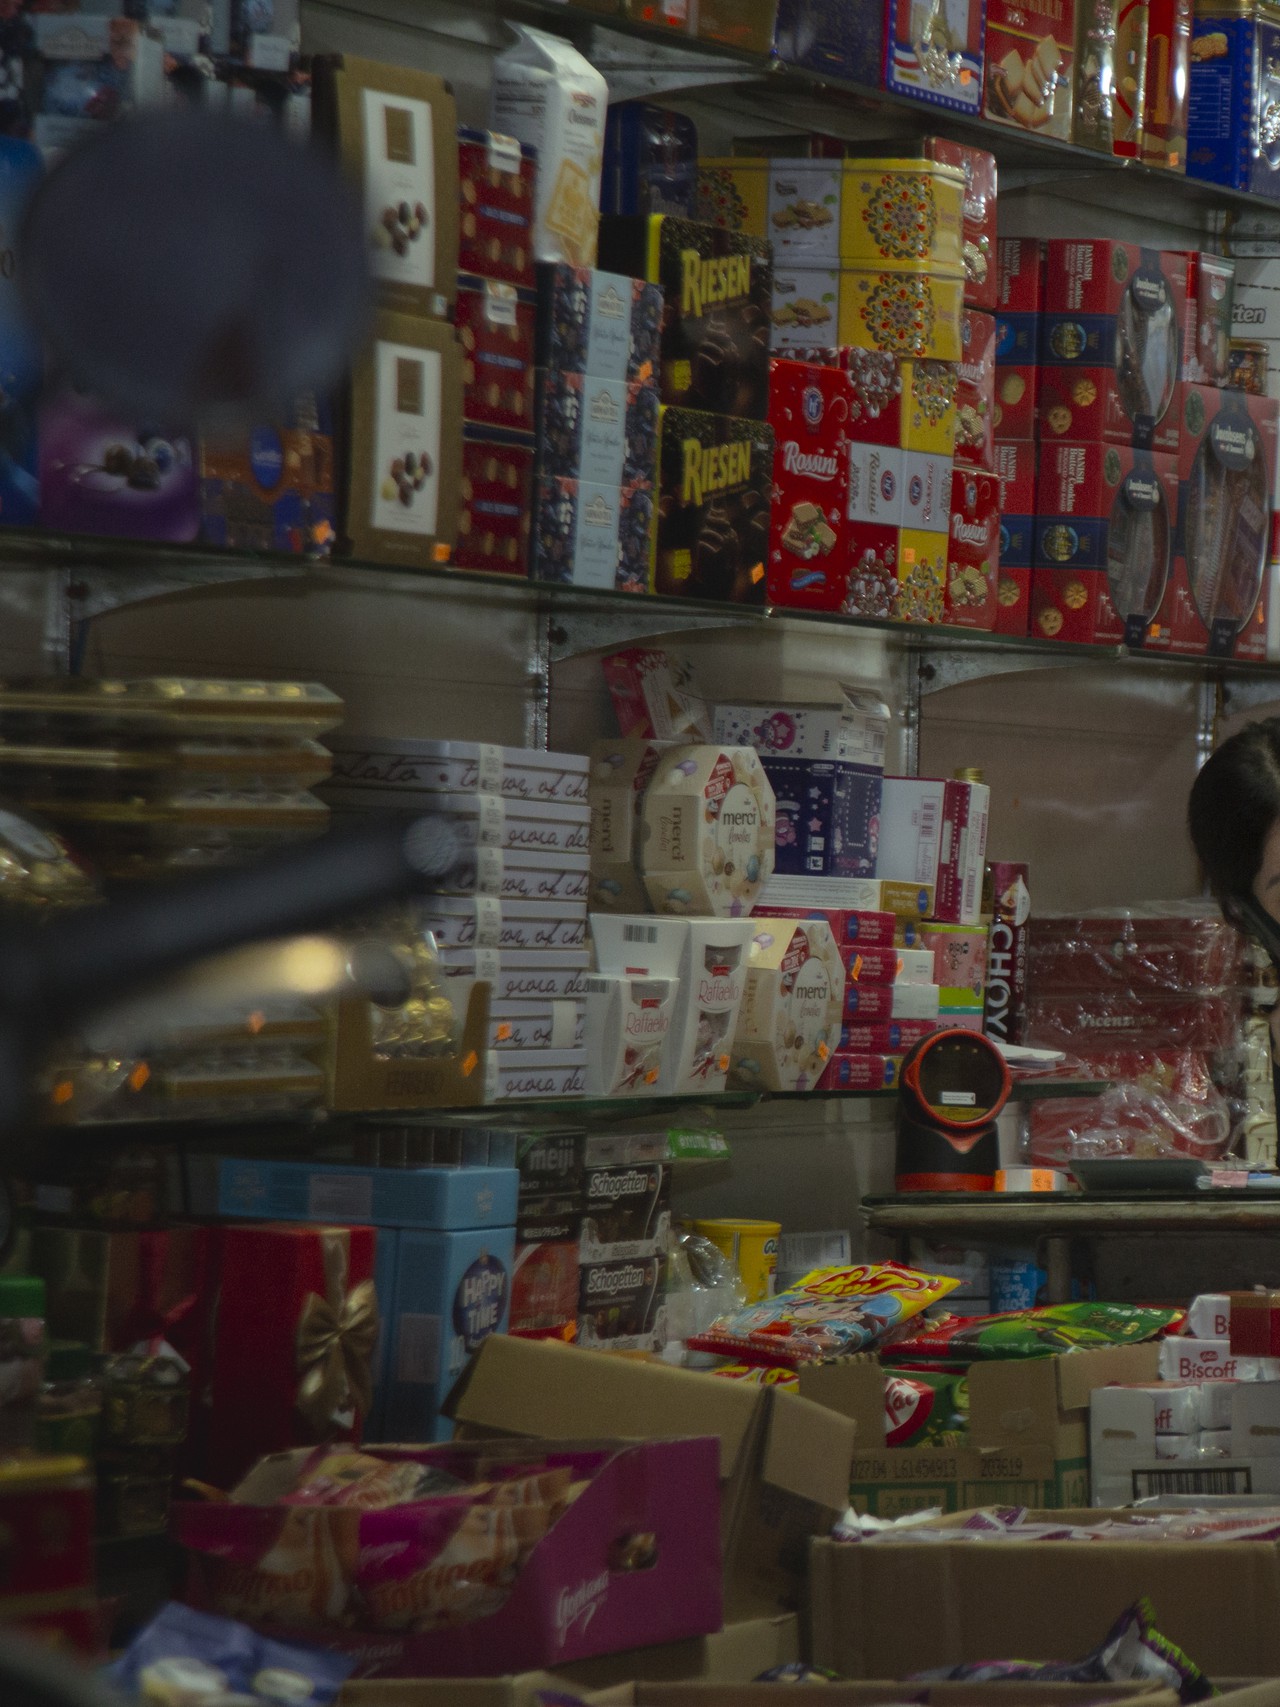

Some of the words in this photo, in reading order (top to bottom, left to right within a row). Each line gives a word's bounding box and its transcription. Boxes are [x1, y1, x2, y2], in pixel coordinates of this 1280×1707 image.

[1076, 245, 1085, 272] Butter
[1084, 244, 1094, 281] DANISH
[680, 248, 752, 318] RIESEN
[1073, 274, 1083, 310] Cookies
[682, 437, 751, 506] RIESEN
[783, 440, 839, 482] Rossini
[1007, 446, 1017, 482] DANISH
[1067, 448, 1077, 476] Butter
[1075, 447, 1086, 484] DANISH
[867, 452, 880, 517] Rossini
[1065, 477, 1076, 513] Cookies
[952, 513, 988, 546] Rossini
[601, 799, 614, 853] merci
[671, 806, 685, 863] merci
[723, 806, 757, 827] merci
[698, 979, 740, 1004] Raffaello
[796, 981, 827, 1000] merci
[624, 1012, 670, 1036] Raffaello
[528, 1138, 576, 1177] meiji
[588, 1170, 648, 1200] Schogetten
[464, 1269, 506, 1309] HAPPY
[587, 1263, 645, 1296] Schogetten
[467, 1302, 498, 1336] TIME
[1179, 1358, 1238, 1379] Biscoff
